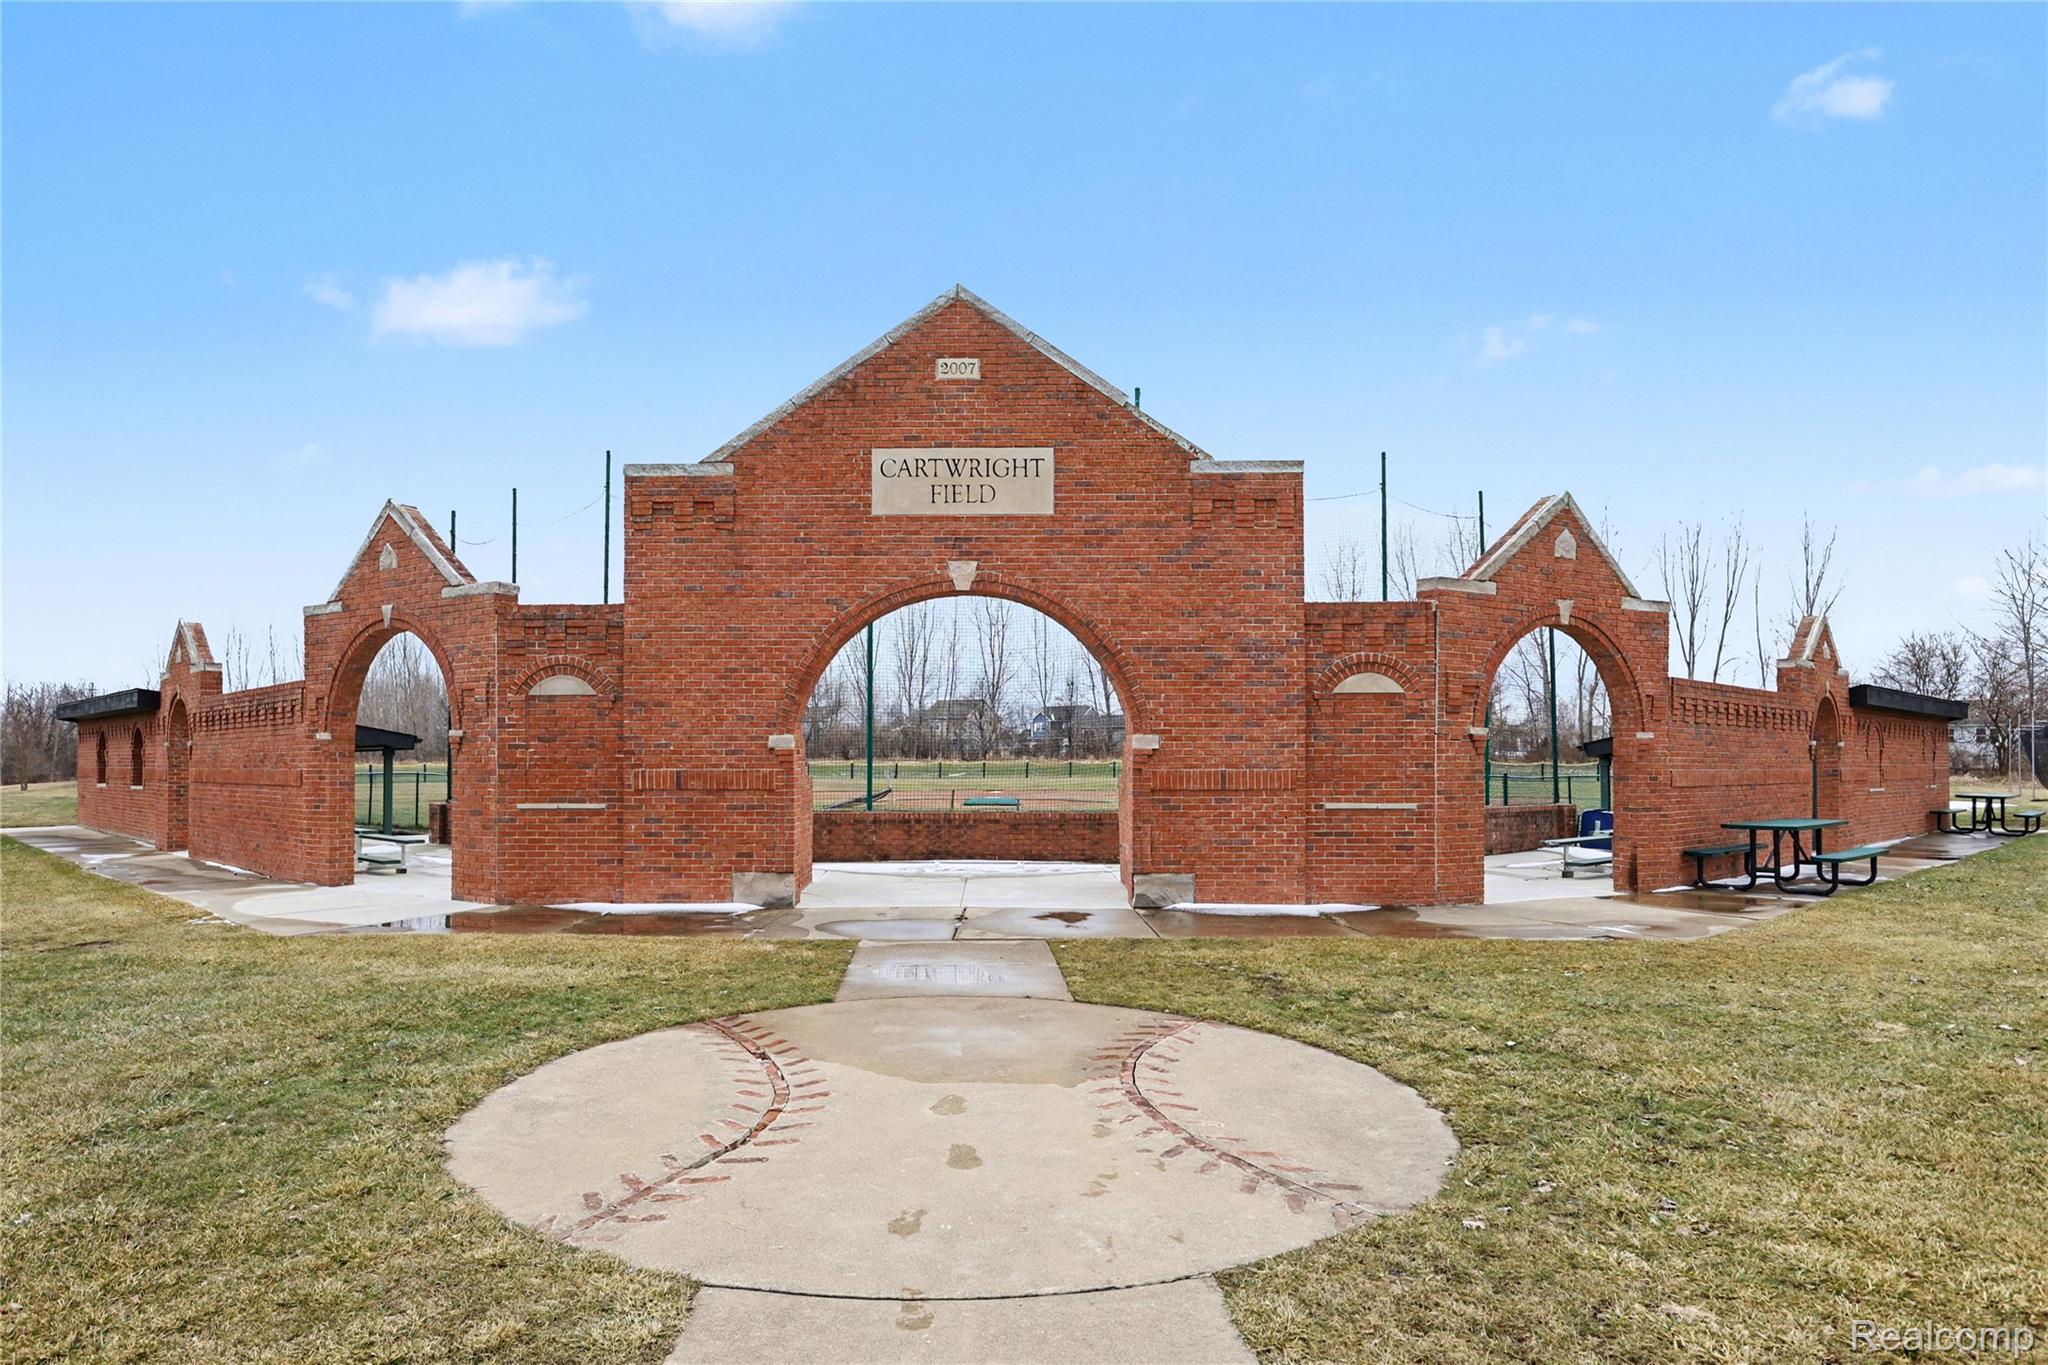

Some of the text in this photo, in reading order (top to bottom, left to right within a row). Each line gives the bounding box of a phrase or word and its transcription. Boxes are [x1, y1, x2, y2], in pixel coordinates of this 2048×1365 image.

[940, 362, 977, 375] 2007
[879, 458, 1046, 479] CARTWRIGHT
[930, 484, 997, 504] FIELD
